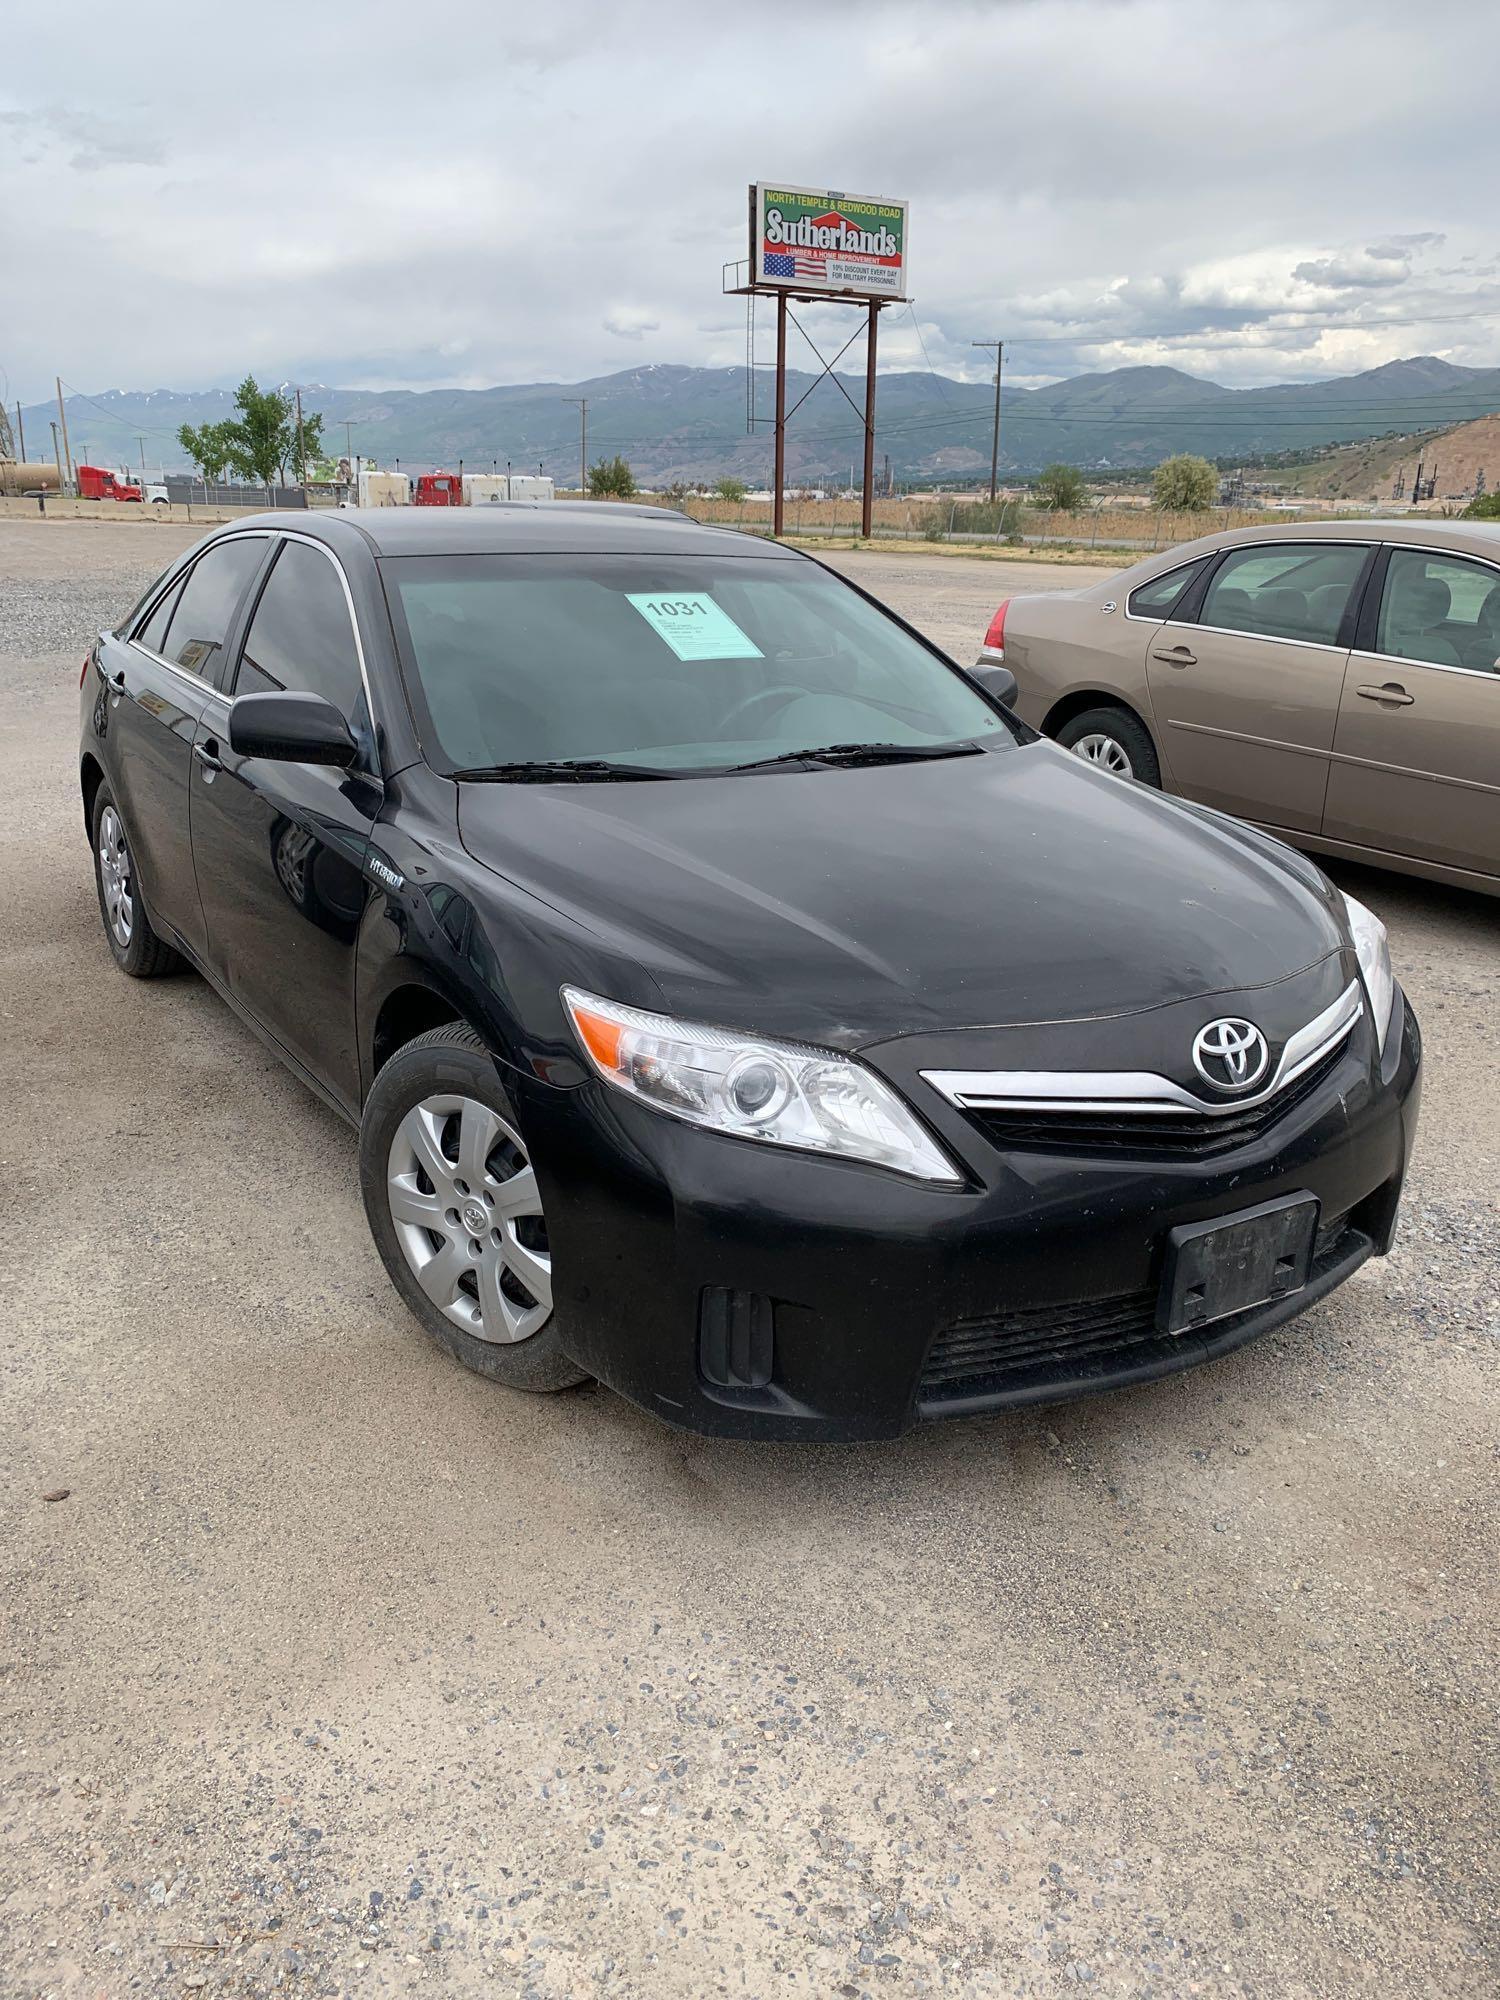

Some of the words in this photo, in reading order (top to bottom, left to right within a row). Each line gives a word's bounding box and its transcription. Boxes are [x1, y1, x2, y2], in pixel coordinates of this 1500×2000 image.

[766, 191, 795, 205] NORTH
[796, 195, 829, 208] TEMPLE
[830, 200, 836, 209] &
[838, 201, 877, 215] REDWOOD
[878, 206, 901, 219] ROAD
[766, 207, 898, 258] Sutherlands
[786, 247, 812, 258] LUMBER
[813, 250, 818, 258] &
[819, 251, 837, 260] HOME
[838, 253, 881, 264] IMPROVEMENT
[832, 271, 843, 279] FOR
[843, 273, 867, 282] MILITARY
[867, 276, 896, 286] PERSONNEL
[844, 265, 870, 275] DISCOUNT
[870, 269, 886, 277] EVERY
[887, 270, 897, 278] DAY
[646, 600, 708, 617] 1031
[369, 857, 398, 885] HYBRID
